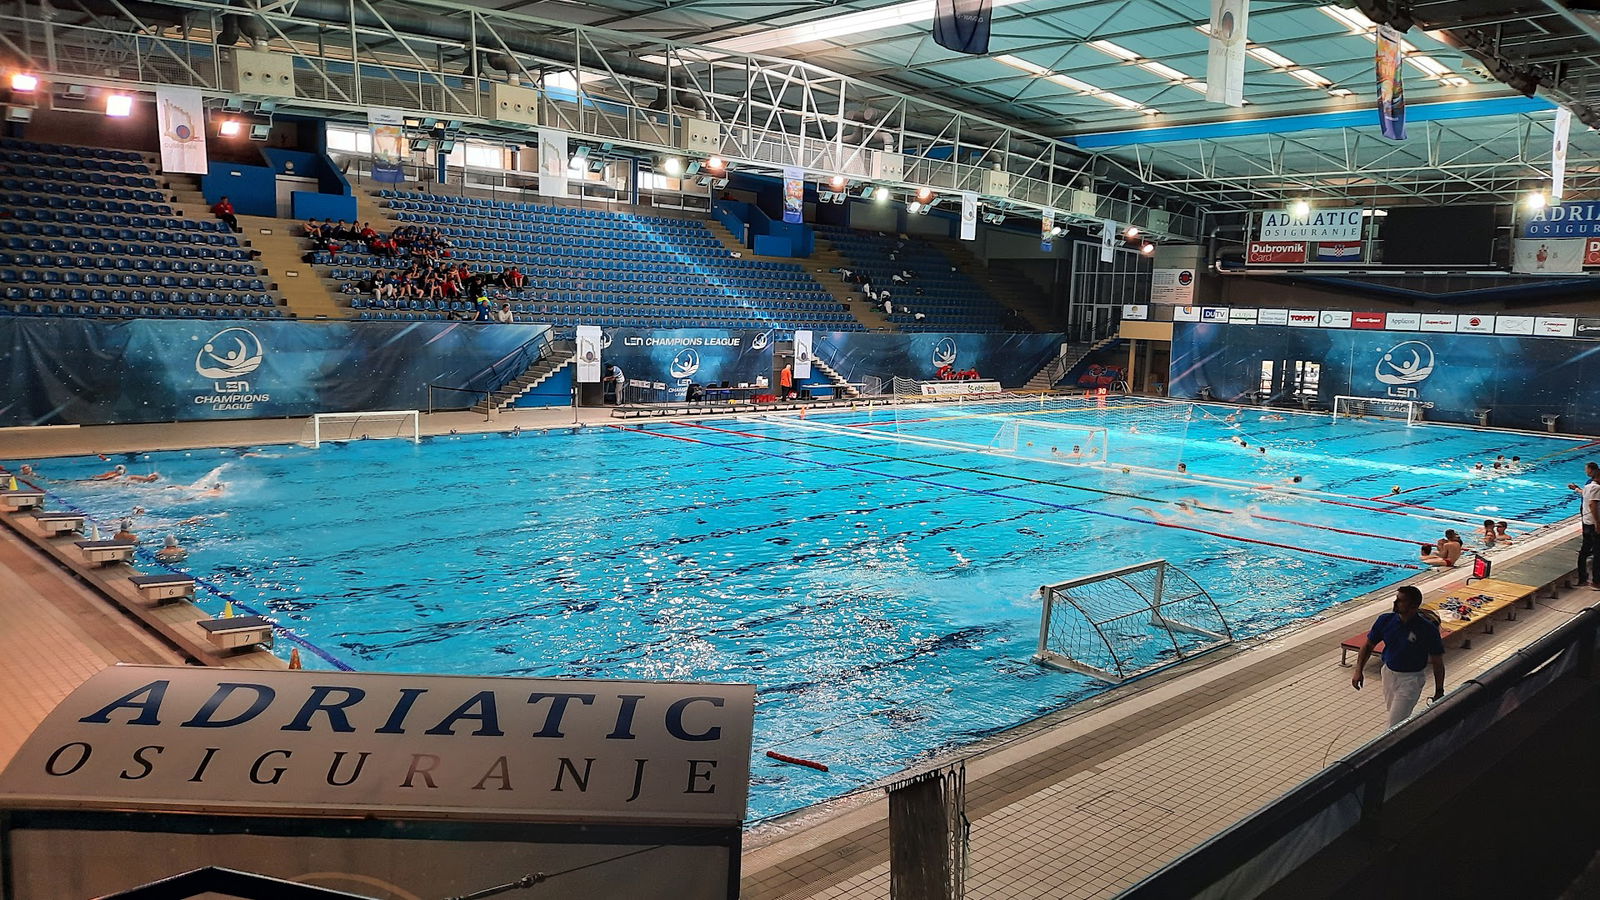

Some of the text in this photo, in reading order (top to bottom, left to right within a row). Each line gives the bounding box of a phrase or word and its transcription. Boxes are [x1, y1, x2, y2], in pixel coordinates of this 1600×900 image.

[1266, 211, 1359, 227] ADRIATIC
[1264, 227, 1357, 237] OSIGURANJE
[1251, 243, 1304, 253] Dubrovnik
[1250, 252, 1272, 262] Card
[624, 337, 741, 346] LEN CHAMPIONS LEAGUE
[214, 380, 250, 393] LEN
[1387, 386, 1417, 398] LEN
[194, 394, 270, 404] CHAMPIONS
[212, 402, 254, 411] LEAGUE
[110, 551, 115, 559] 5
[244, 634, 250, 642] 7
[78, 680, 726, 741] ADRIATIC
[45, 742, 718, 803] OSIGURANJE
